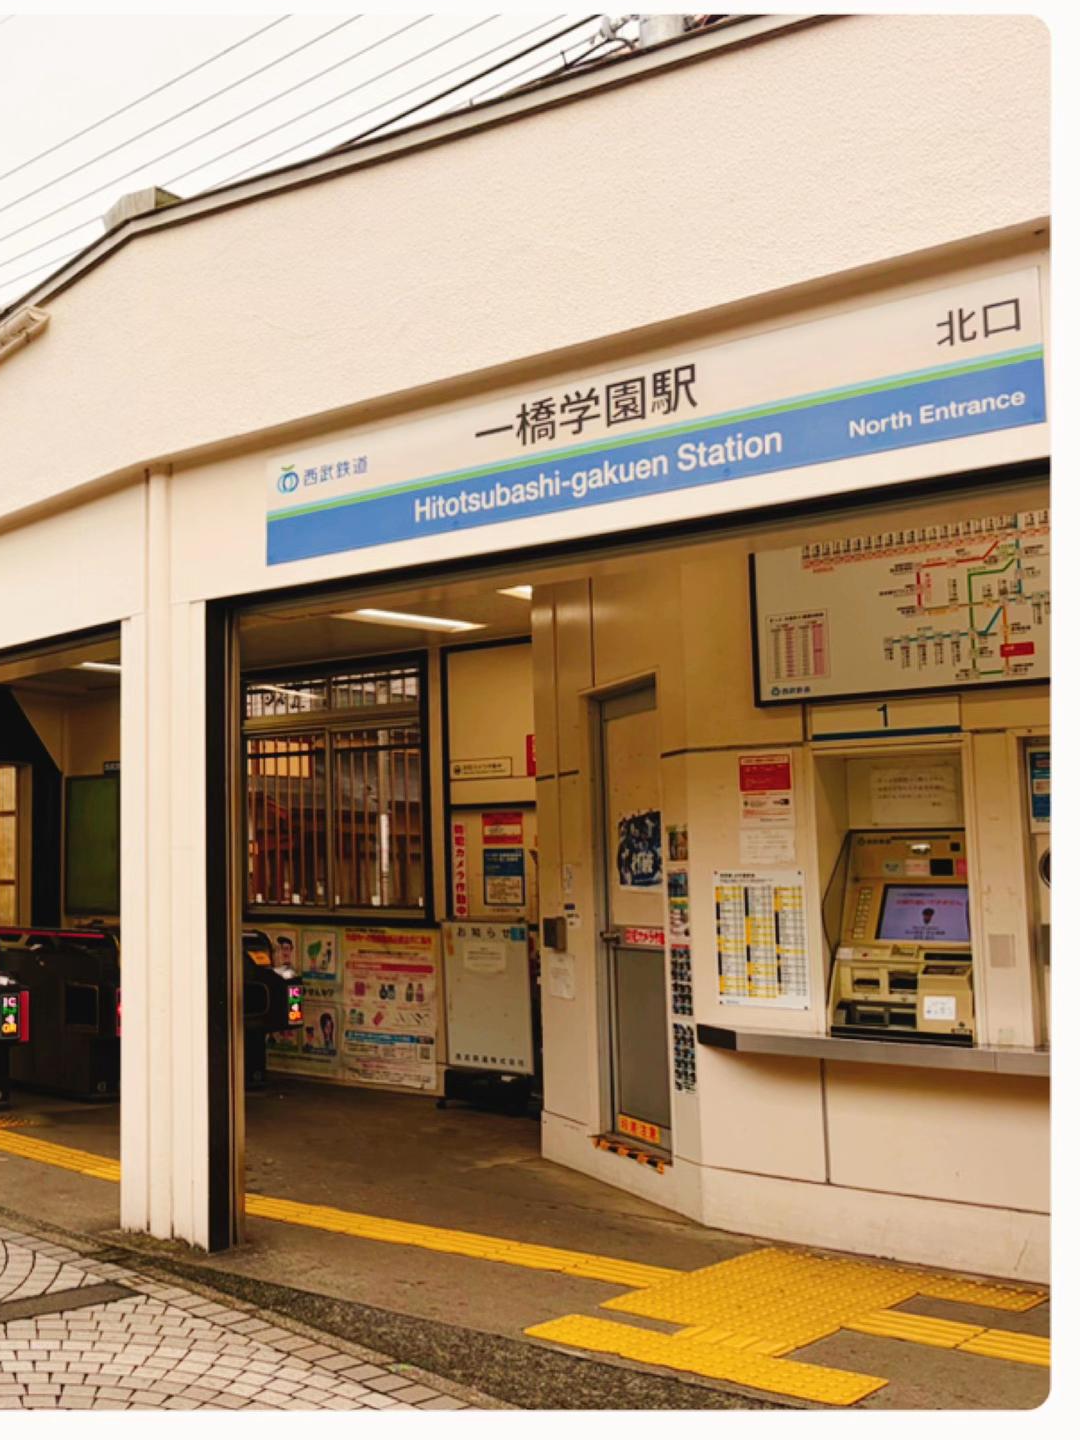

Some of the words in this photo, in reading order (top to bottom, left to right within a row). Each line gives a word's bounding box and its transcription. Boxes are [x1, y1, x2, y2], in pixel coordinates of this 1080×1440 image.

[936, 298, 1022, 348] 北口
[474, 364, 699, 450] 一橋学園駅
[848, 410, 913, 439] North
[919, 389, 1026, 427] Entrance
[303, 455, 369, 488] 西武鉄道
[414, 453, 670, 524] Hitotsubashi-gakuen
[676, 428, 782, 473] Station
[877, 703, 888, 727] 1
[3, 997, 17, 1007] IC
